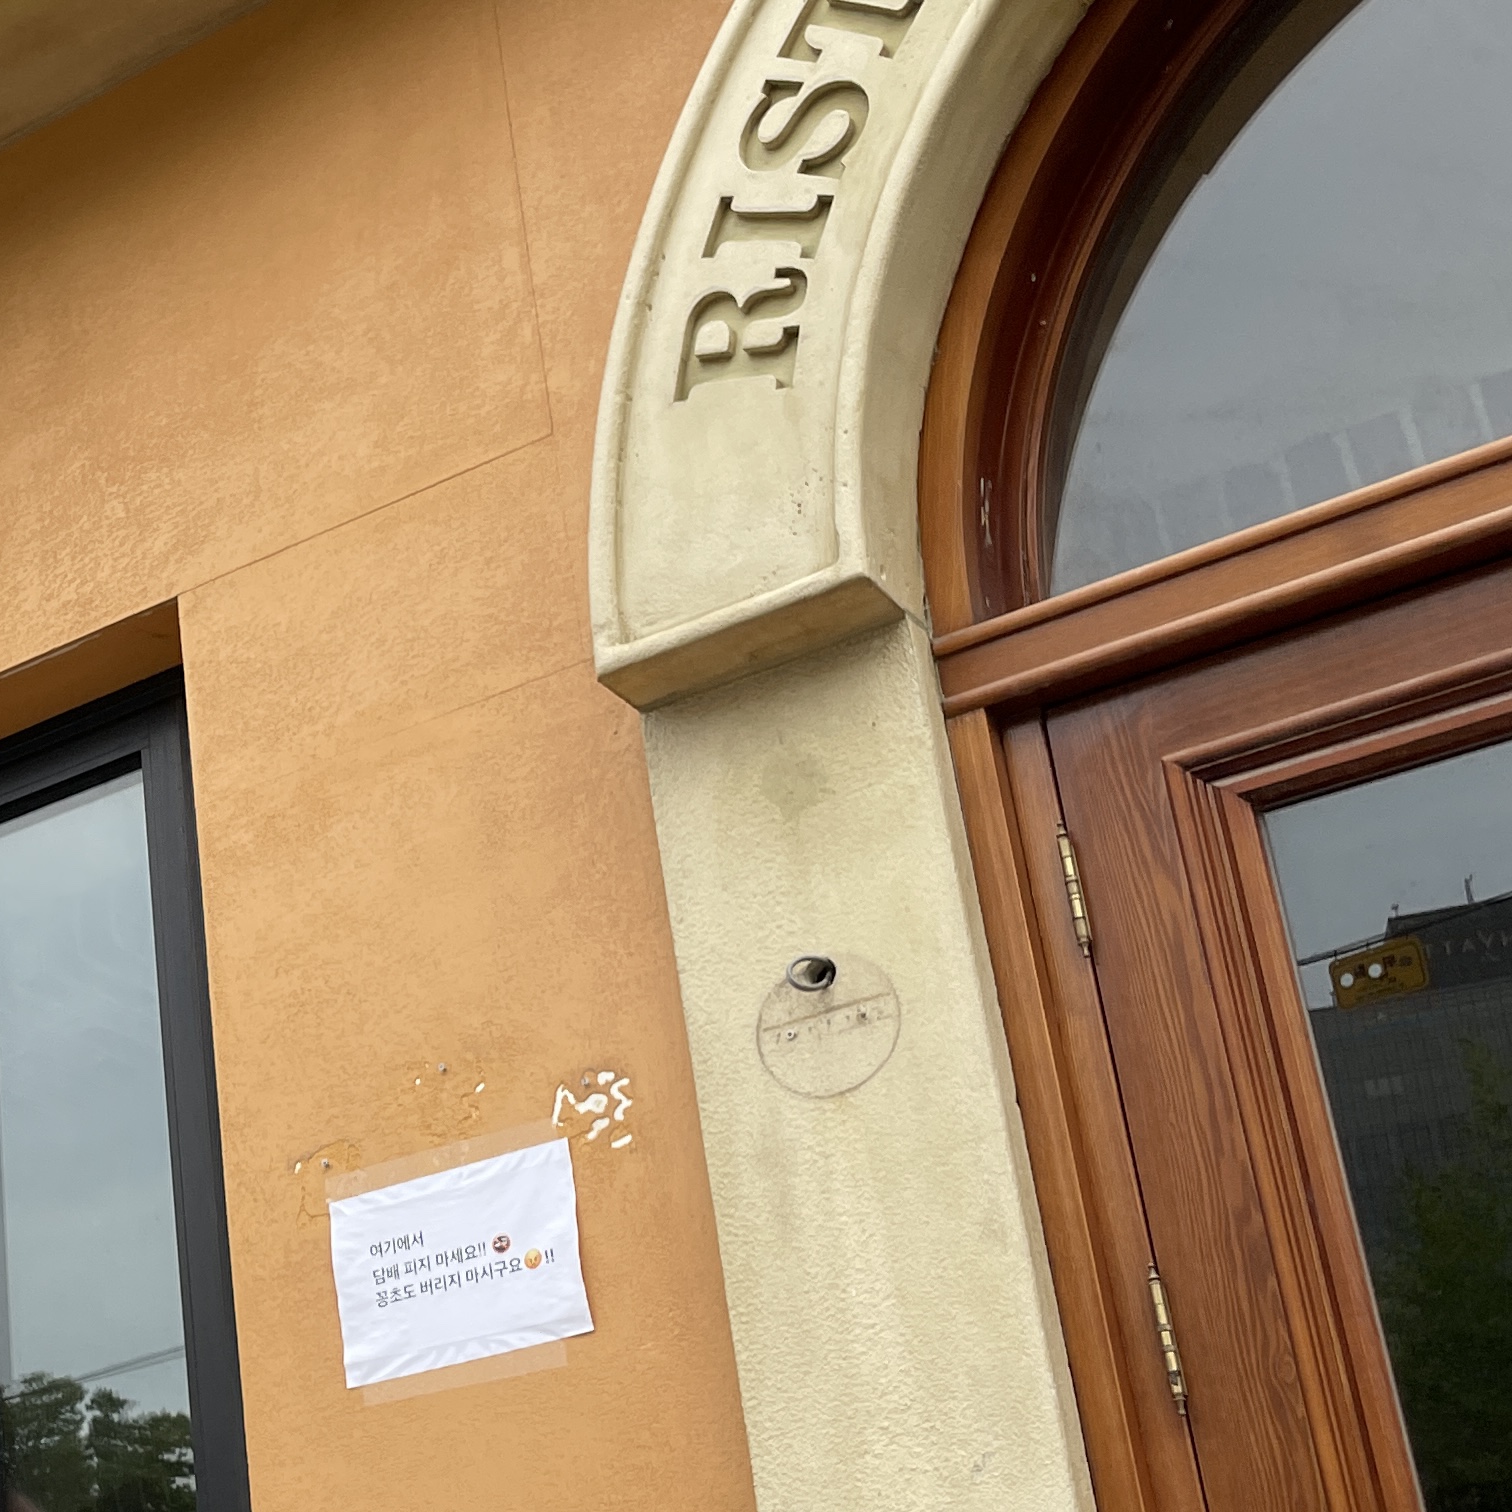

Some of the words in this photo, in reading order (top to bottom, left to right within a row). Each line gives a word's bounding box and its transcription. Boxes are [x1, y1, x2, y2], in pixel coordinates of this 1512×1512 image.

[370, 1230, 424, 1258] 여기에서
[372, 1263, 400, 1286] 담배
[404, 1255, 431, 1276] 피지
[435, 1241, 487, 1268] 마세요!!
[375, 1283, 417, 1308] 꽁초도
[420, 1270, 462, 1296] 버리지
